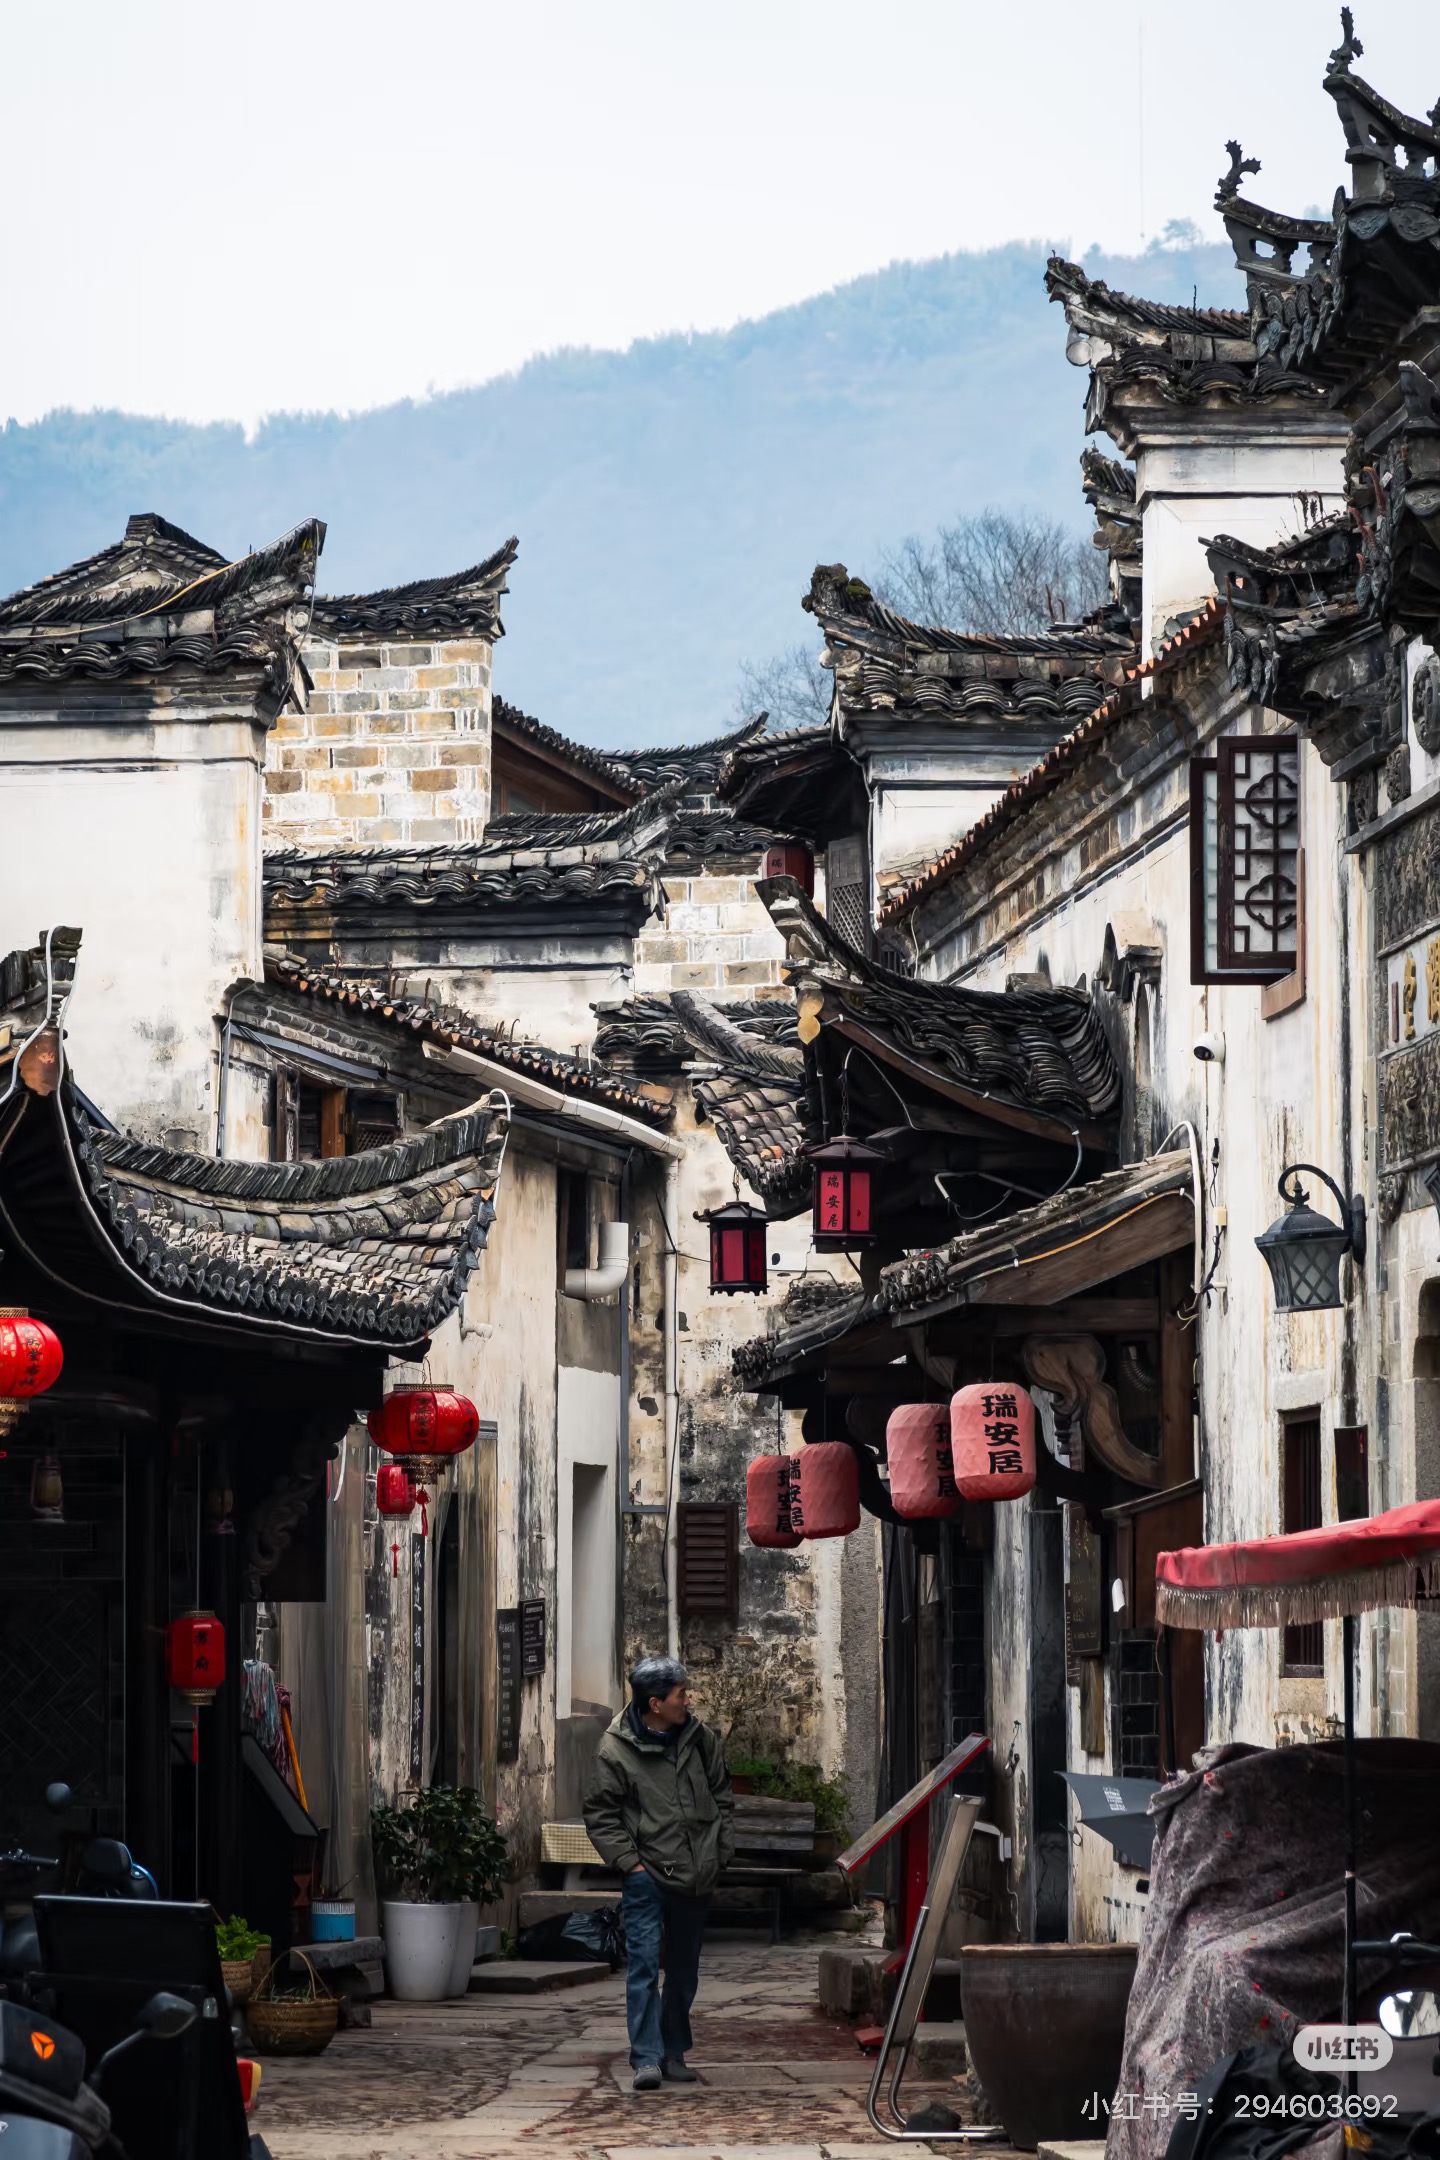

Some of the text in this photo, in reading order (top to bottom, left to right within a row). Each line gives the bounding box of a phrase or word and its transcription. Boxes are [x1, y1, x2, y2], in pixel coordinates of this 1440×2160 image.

[826, 1175, 840, 1228] 瑞安居
[980, 1393, 1023, 1474] 瑞安居
